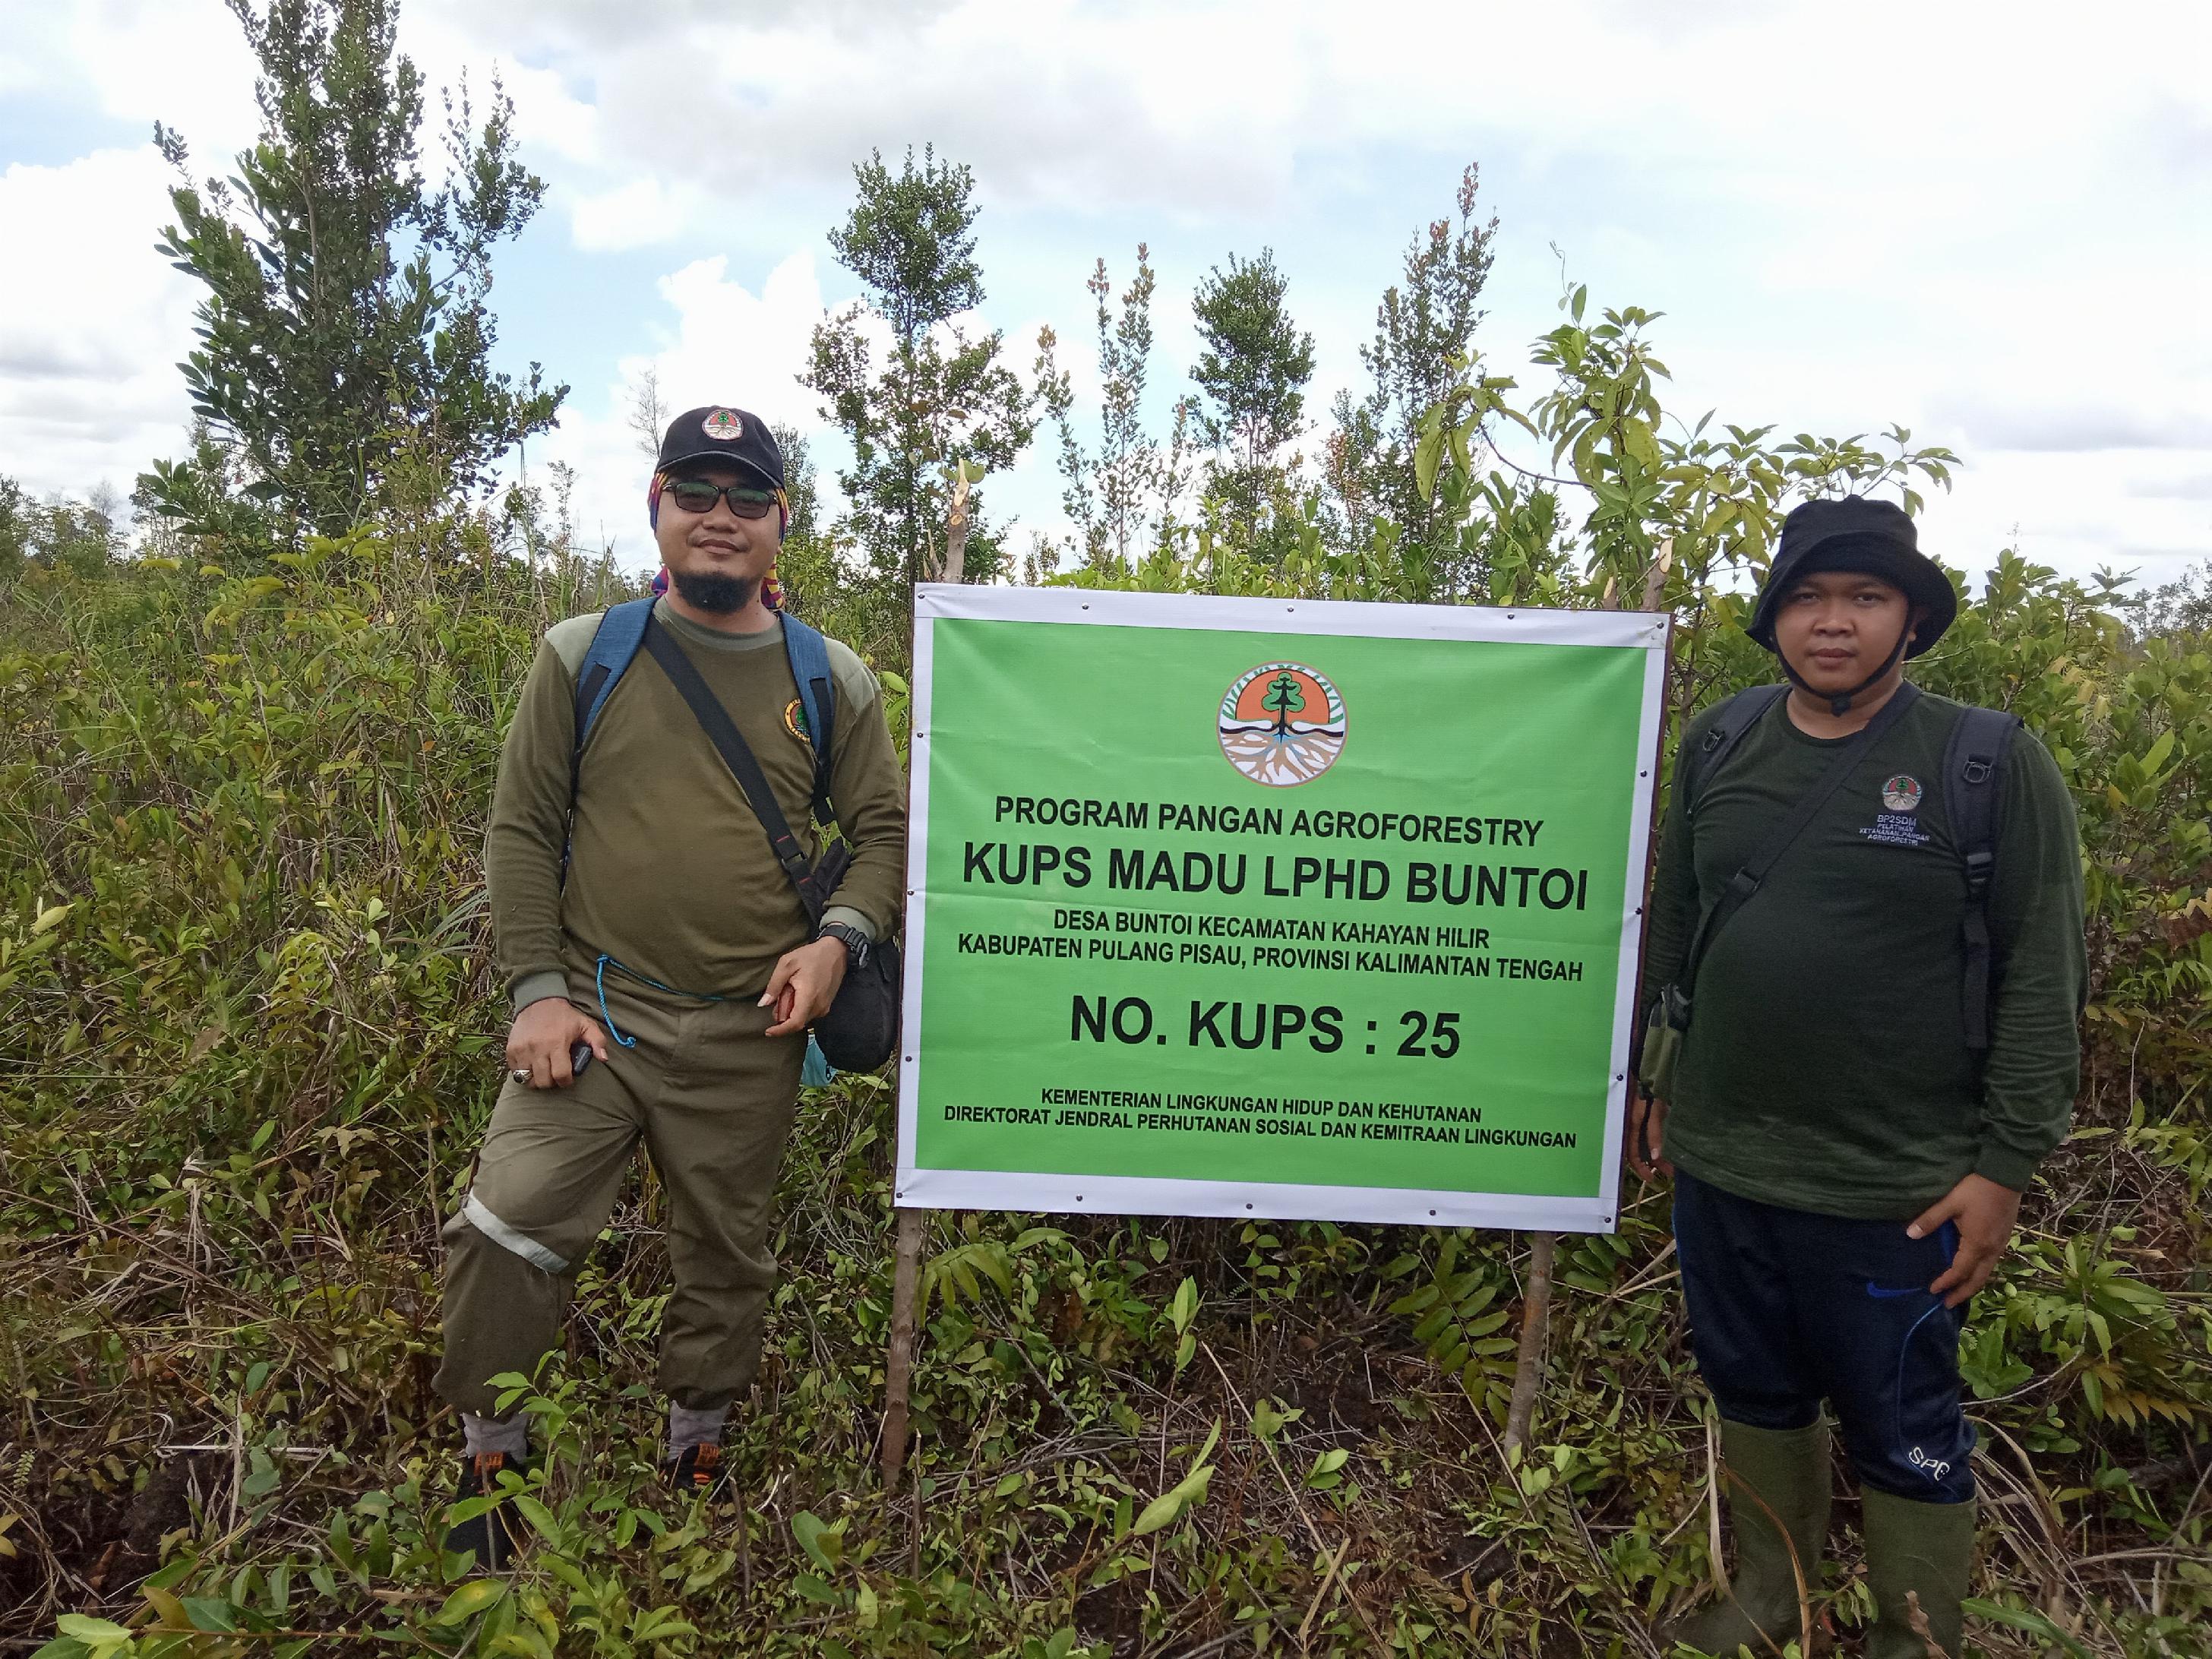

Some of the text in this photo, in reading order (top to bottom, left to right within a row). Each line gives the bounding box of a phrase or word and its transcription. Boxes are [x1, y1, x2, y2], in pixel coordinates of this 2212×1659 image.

[995, 795, 1544, 847] PROGRAM PANGAN AGROFORESTRY
[1877, 814, 1917, 827] BP2SDM
[963, 841, 1588, 911] KUPS MADU LPHD BUNTOI
[1054, 908, 1490, 950] DESA BUNTOI KECAMATAN KAHAYAN HILIR
[958, 933, 1583, 982] KABUPATEN PULANG PISAU, PROVINSI KALIMANTAN TENGAH
[1071, 994, 1460, 1059] NO. KUPS : 25
[943, 1105, 1577, 1149] DIREKTORAT JENDRAL PERHUTANAN SOSIAL DAN KEMITRAAN LINGKUNGAN
[1041, 1088, 1482, 1123] KEMENTERIAN LINGKUNGAN HIDUP DAN KEHUTANAN
